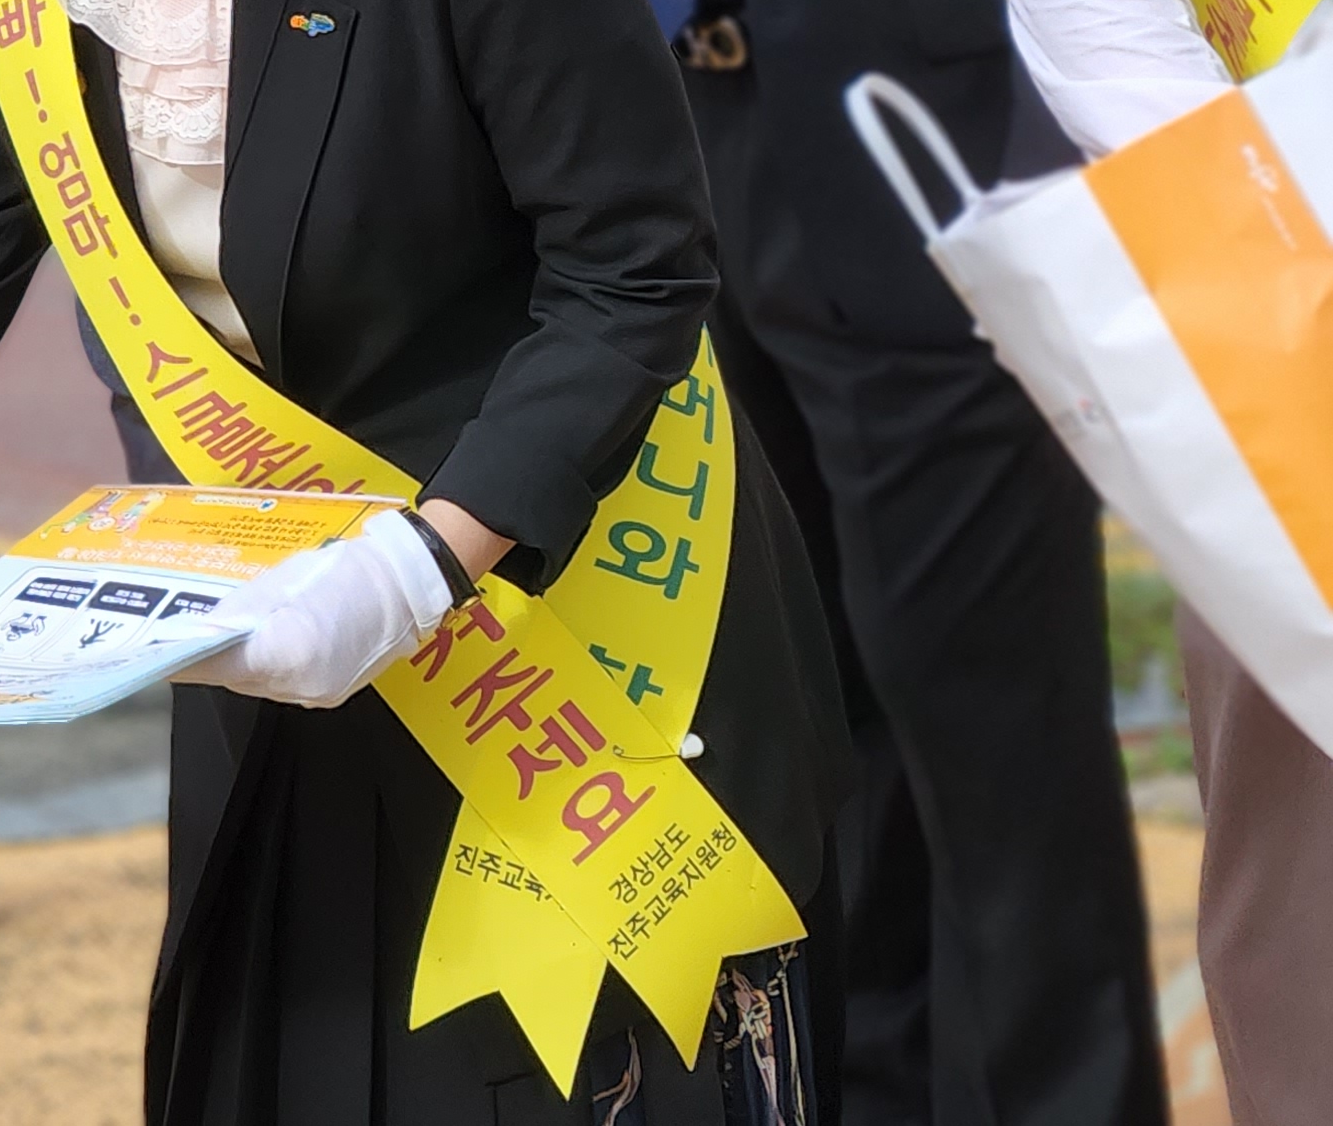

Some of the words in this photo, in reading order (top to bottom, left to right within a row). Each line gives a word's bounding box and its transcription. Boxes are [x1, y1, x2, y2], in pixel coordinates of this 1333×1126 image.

[38, 130, 143, 327] 엄마!
[593, 364, 715, 601] 머니와
[409, 601, 656, 867] 켜주세요
[606, 820, 738, 961] 진주교육지원청
[608, 822, 692, 904] 경상남도
